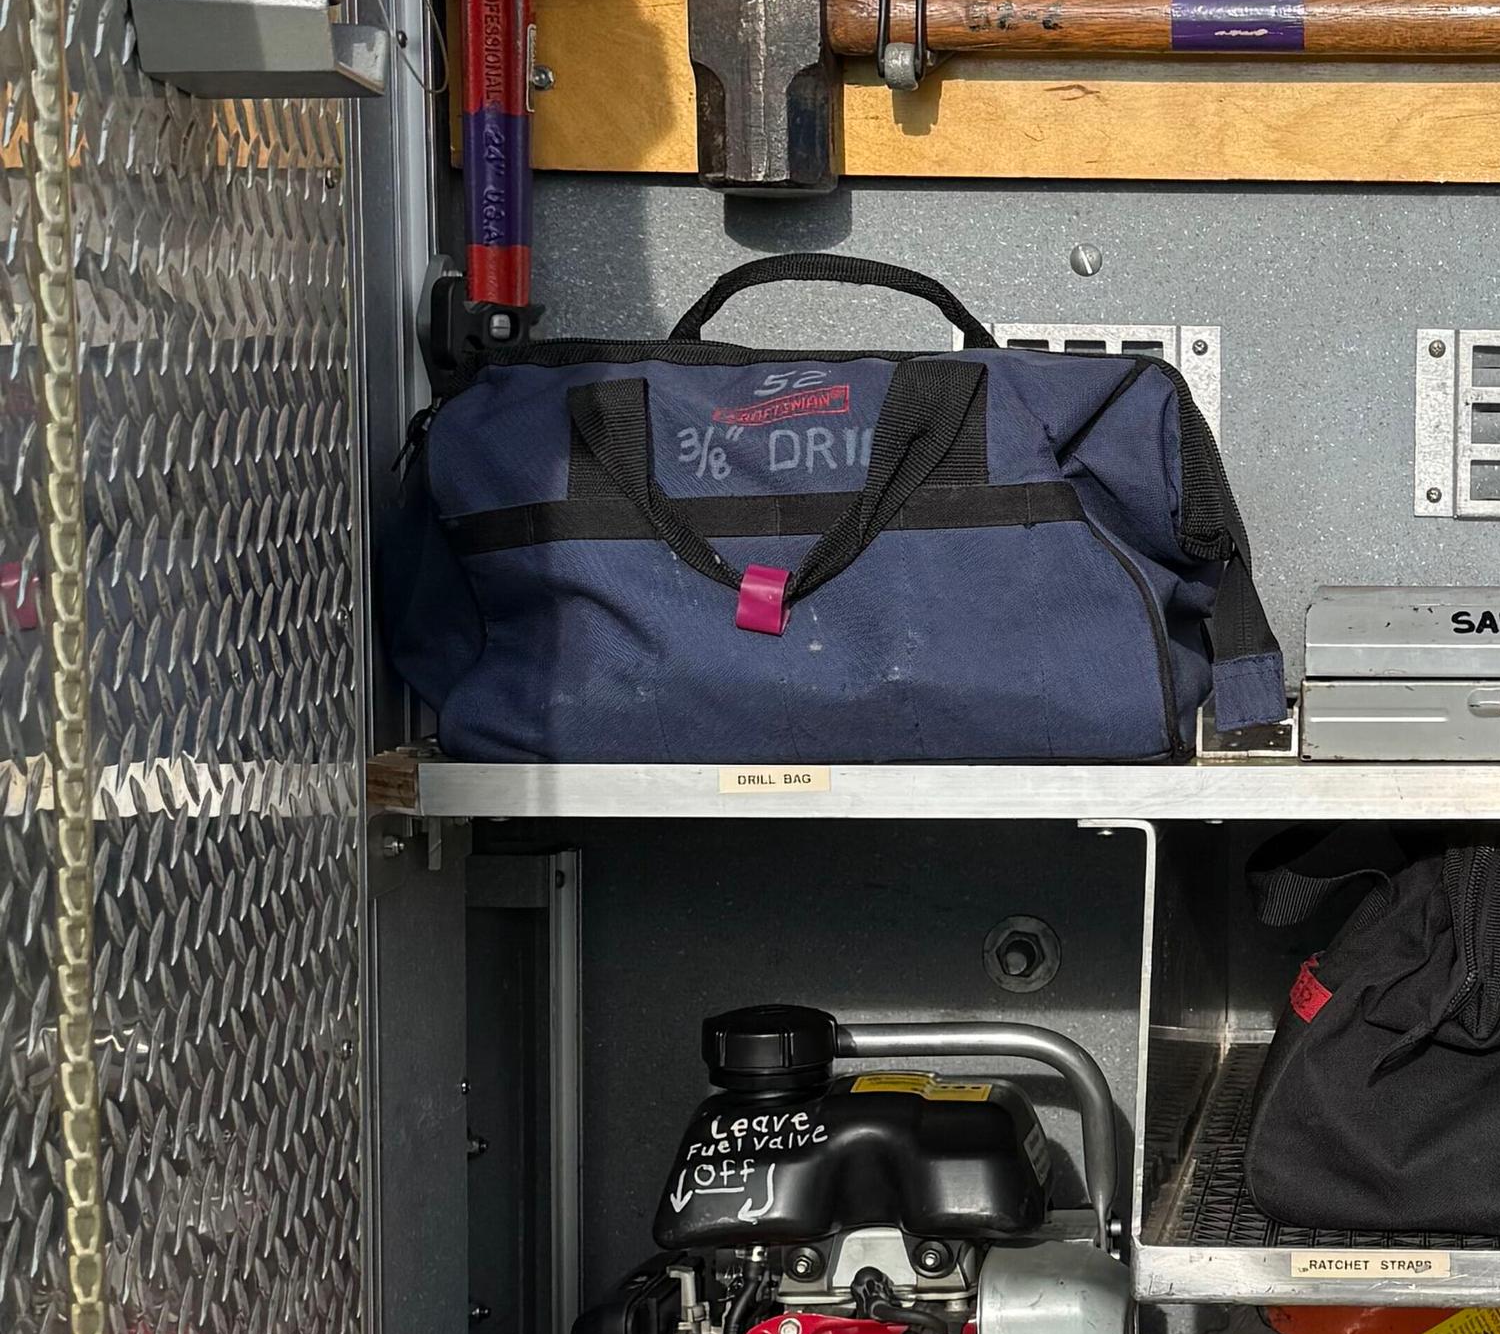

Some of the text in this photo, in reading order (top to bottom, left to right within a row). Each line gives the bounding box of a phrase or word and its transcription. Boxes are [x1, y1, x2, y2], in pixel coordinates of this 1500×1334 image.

[753, 370, 828, 397] 52
[737, 773, 812, 786] DRILL BAG
[711, 1111, 810, 1140] Leave
[686, 1138, 743, 1161] Fuel
[1309, 1260, 1432, 1271] RATCHET STRAPS
